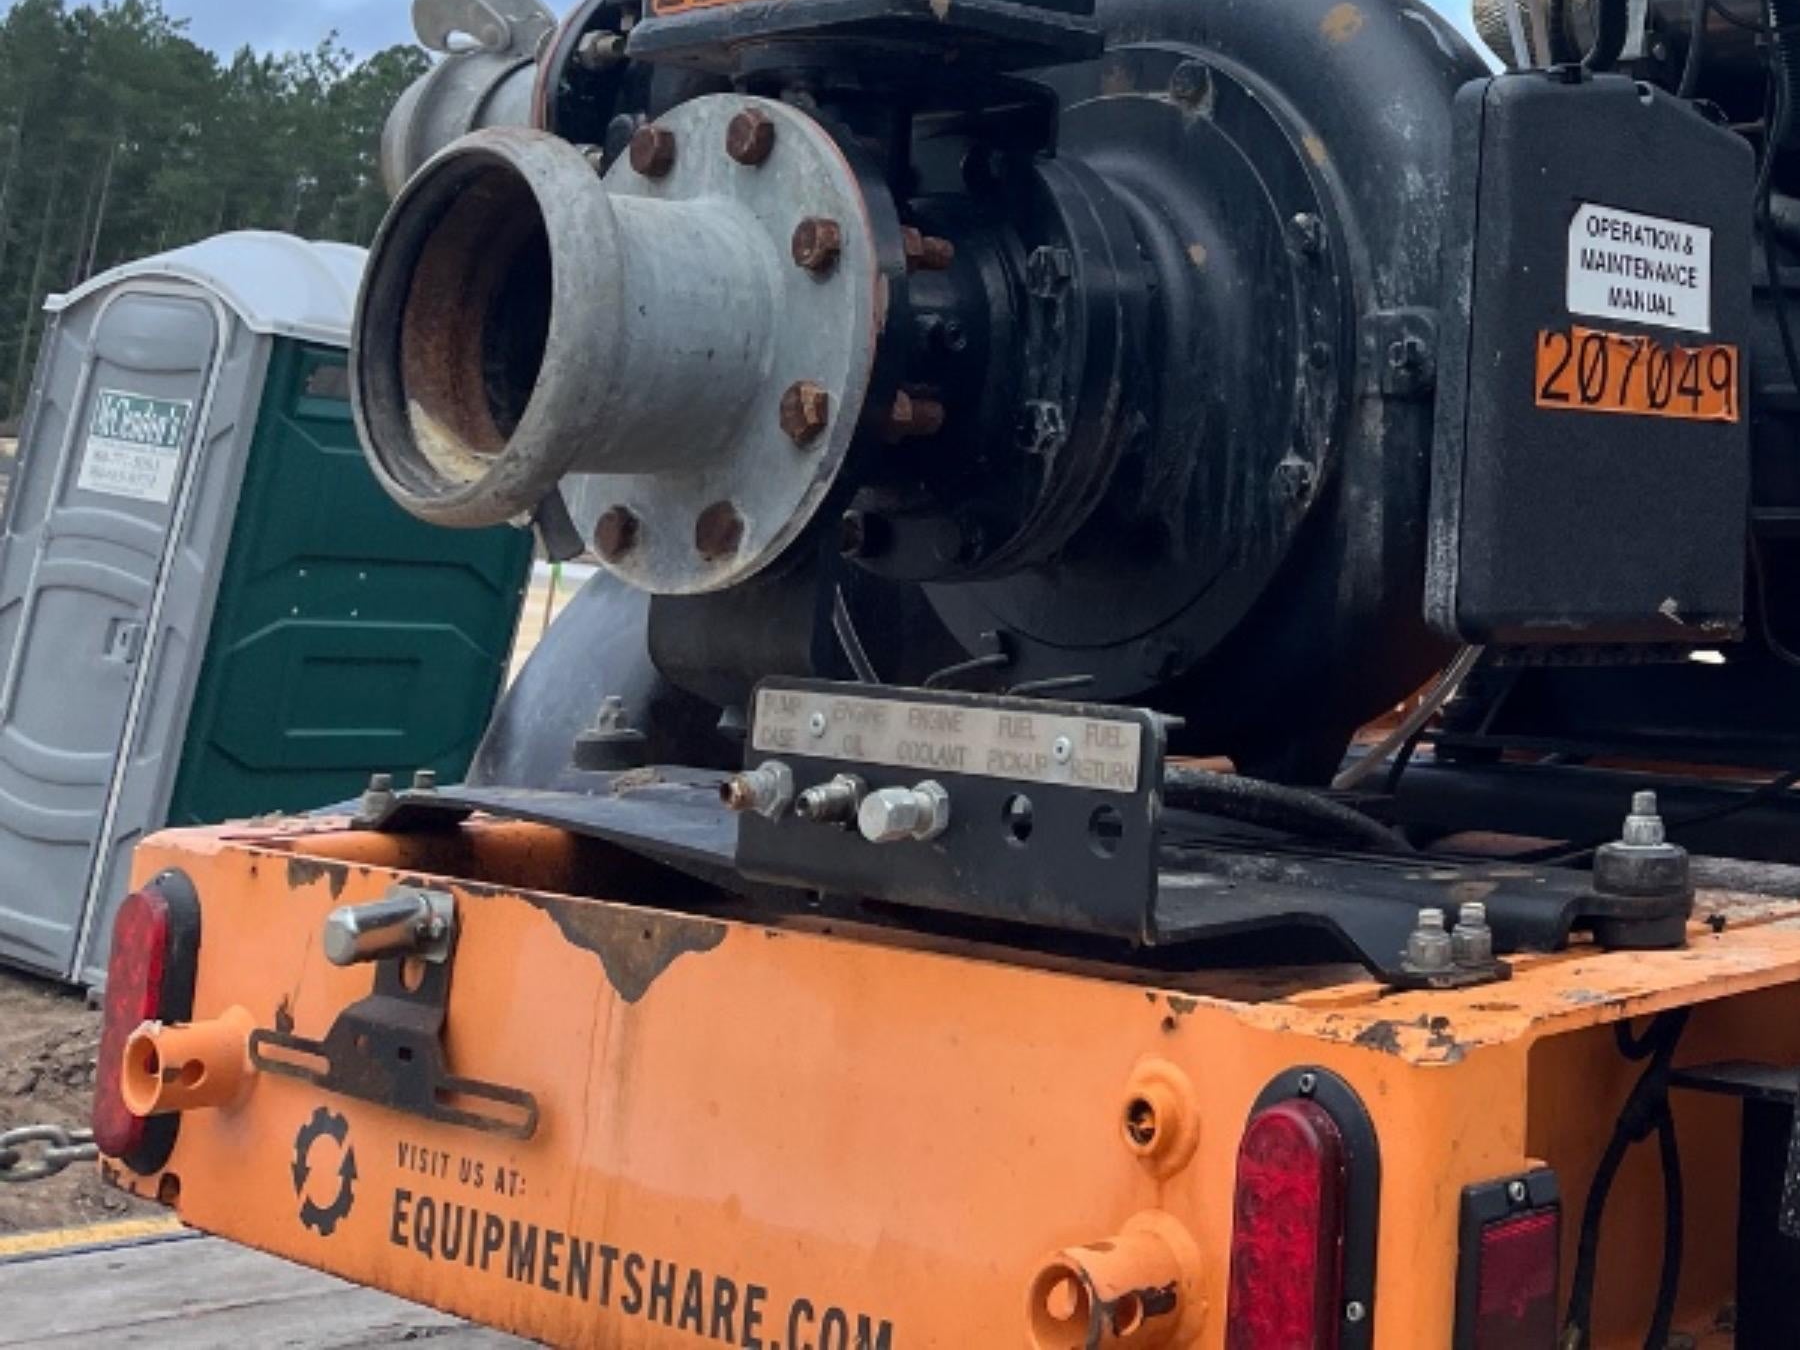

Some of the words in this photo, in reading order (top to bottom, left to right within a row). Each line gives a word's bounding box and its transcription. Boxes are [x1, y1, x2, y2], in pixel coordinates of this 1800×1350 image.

[1586, 215, 1681, 253] OPERATION
[1682, 235, 1694, 256] &
[1580, 248, 1698, 289] MAINTENANCE
[1607, 286, 1676, 317] MANUAL
[1540, 333, 1733, 415] 207049
[909, 706, 964, 732] ENGINE
[999, 714, 1036, 740] FUEL
[1086, 723, 1129, 748] FUEL
[897, 740, 968, 767] COOLANT
[1071, 759, 1135, 787] RETURN
[398, 1139, 451, 1179] VISIT
[459, 1157, 484, 1189] US
[494, 1166, 526, 1198] AT:
[389, 1187, 893, 1350] EQUIPMENTSHARE.COM
